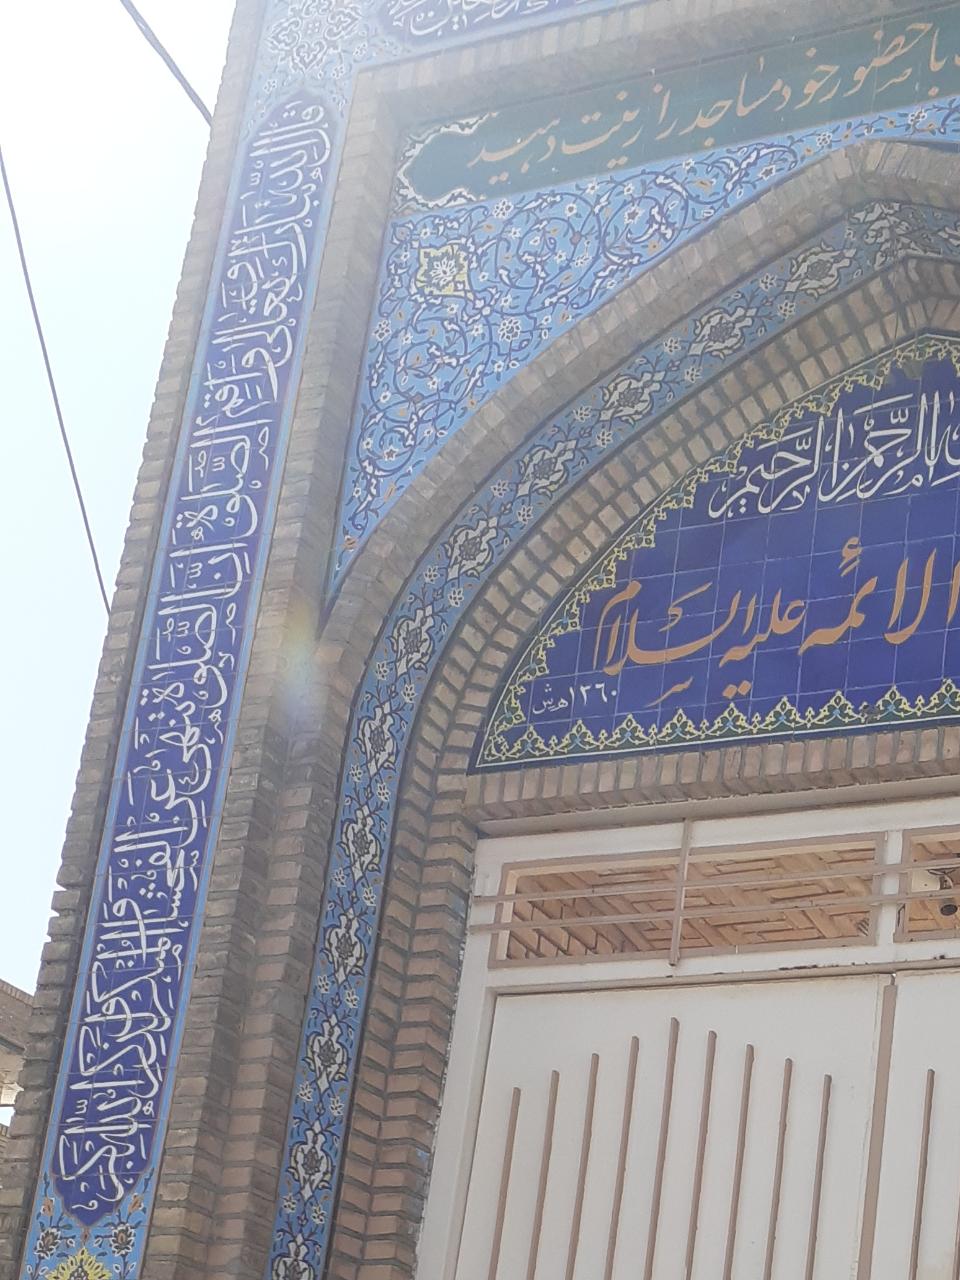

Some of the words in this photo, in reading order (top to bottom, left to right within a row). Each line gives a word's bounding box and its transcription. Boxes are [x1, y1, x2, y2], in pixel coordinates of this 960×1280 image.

[774, 47, 841, 111] خود
[818, 23, 933, 104] حضور
[929, 27, 949, 97] با
[679, 70, 784, 148] مساجد
[593, 579, 757, 676] السلام
